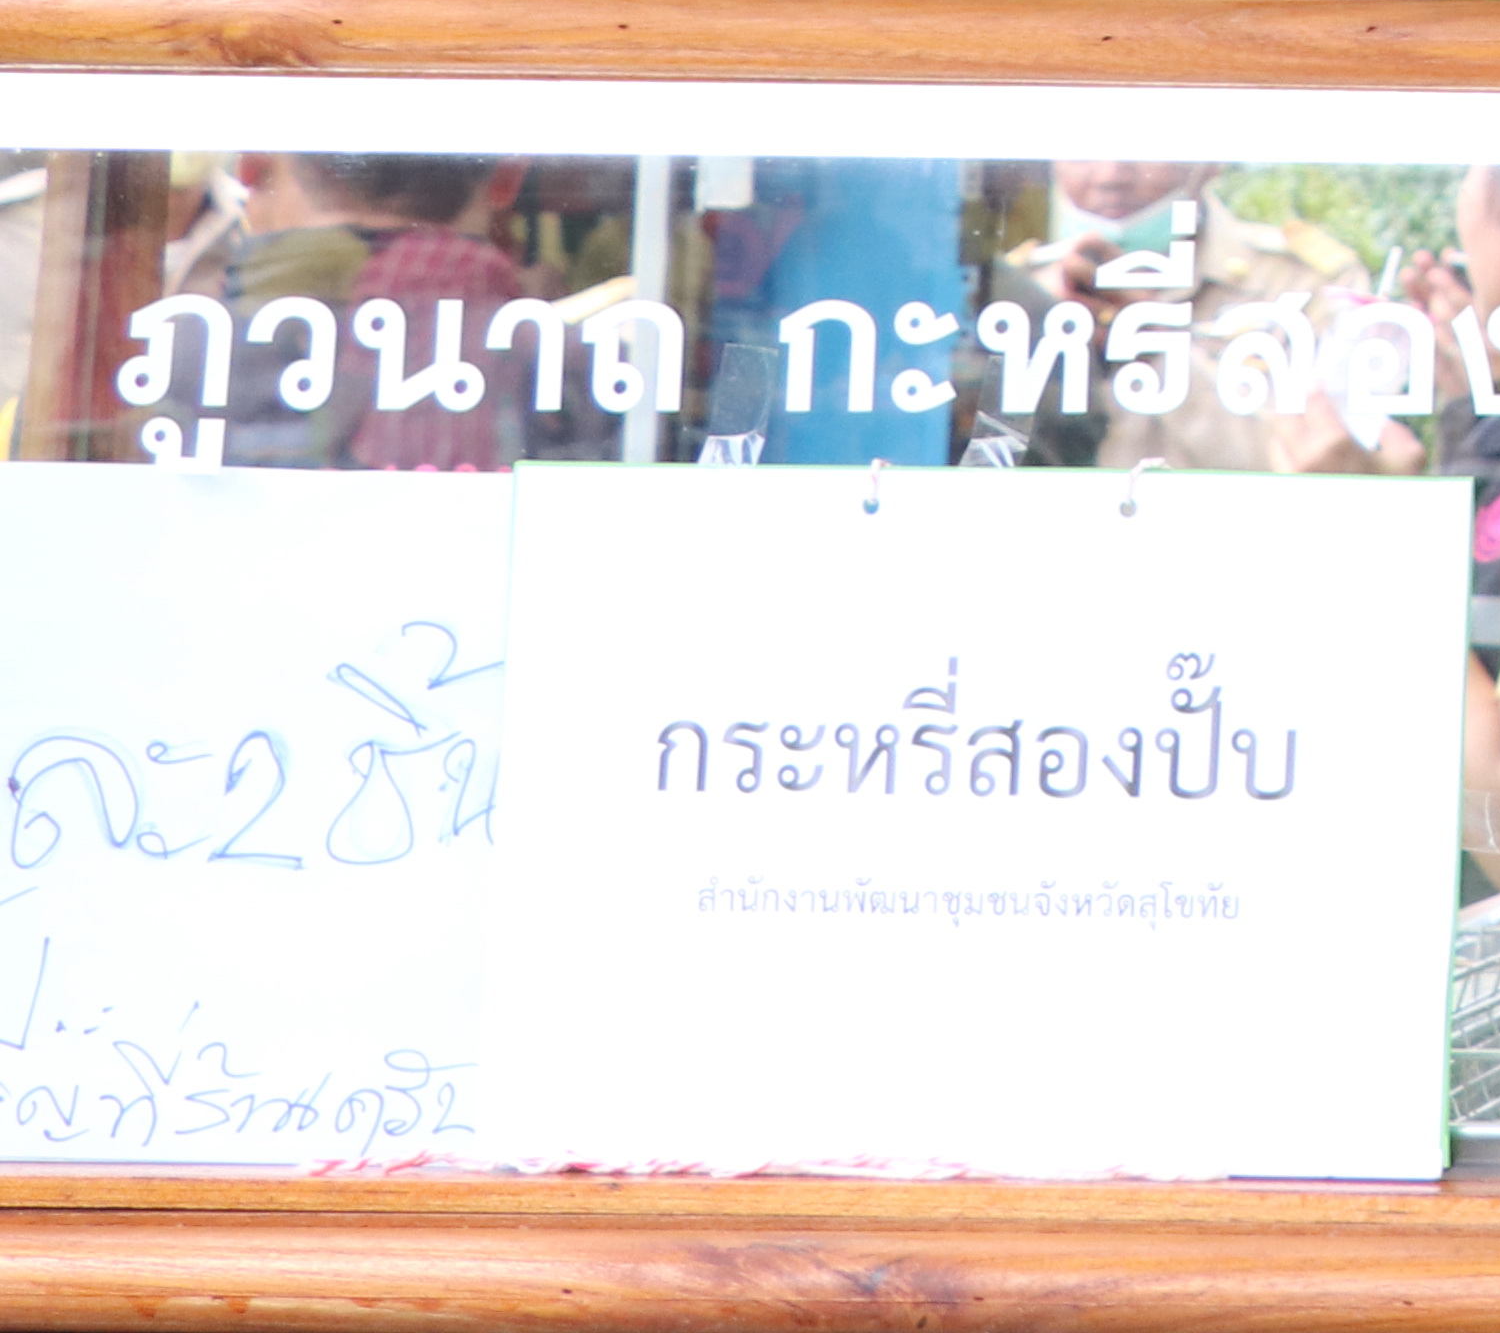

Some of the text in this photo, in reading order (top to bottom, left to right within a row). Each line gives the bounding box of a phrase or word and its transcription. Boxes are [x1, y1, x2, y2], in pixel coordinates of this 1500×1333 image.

[116, 290, 685, 471] ภูวนาถ
[656, 651, 1298, 801] กระหรี่สองปั๊บ
[697, 876, 1240, 930] สำนักงานพัฒนาชุมชนจังหวัดสุโขทัย
